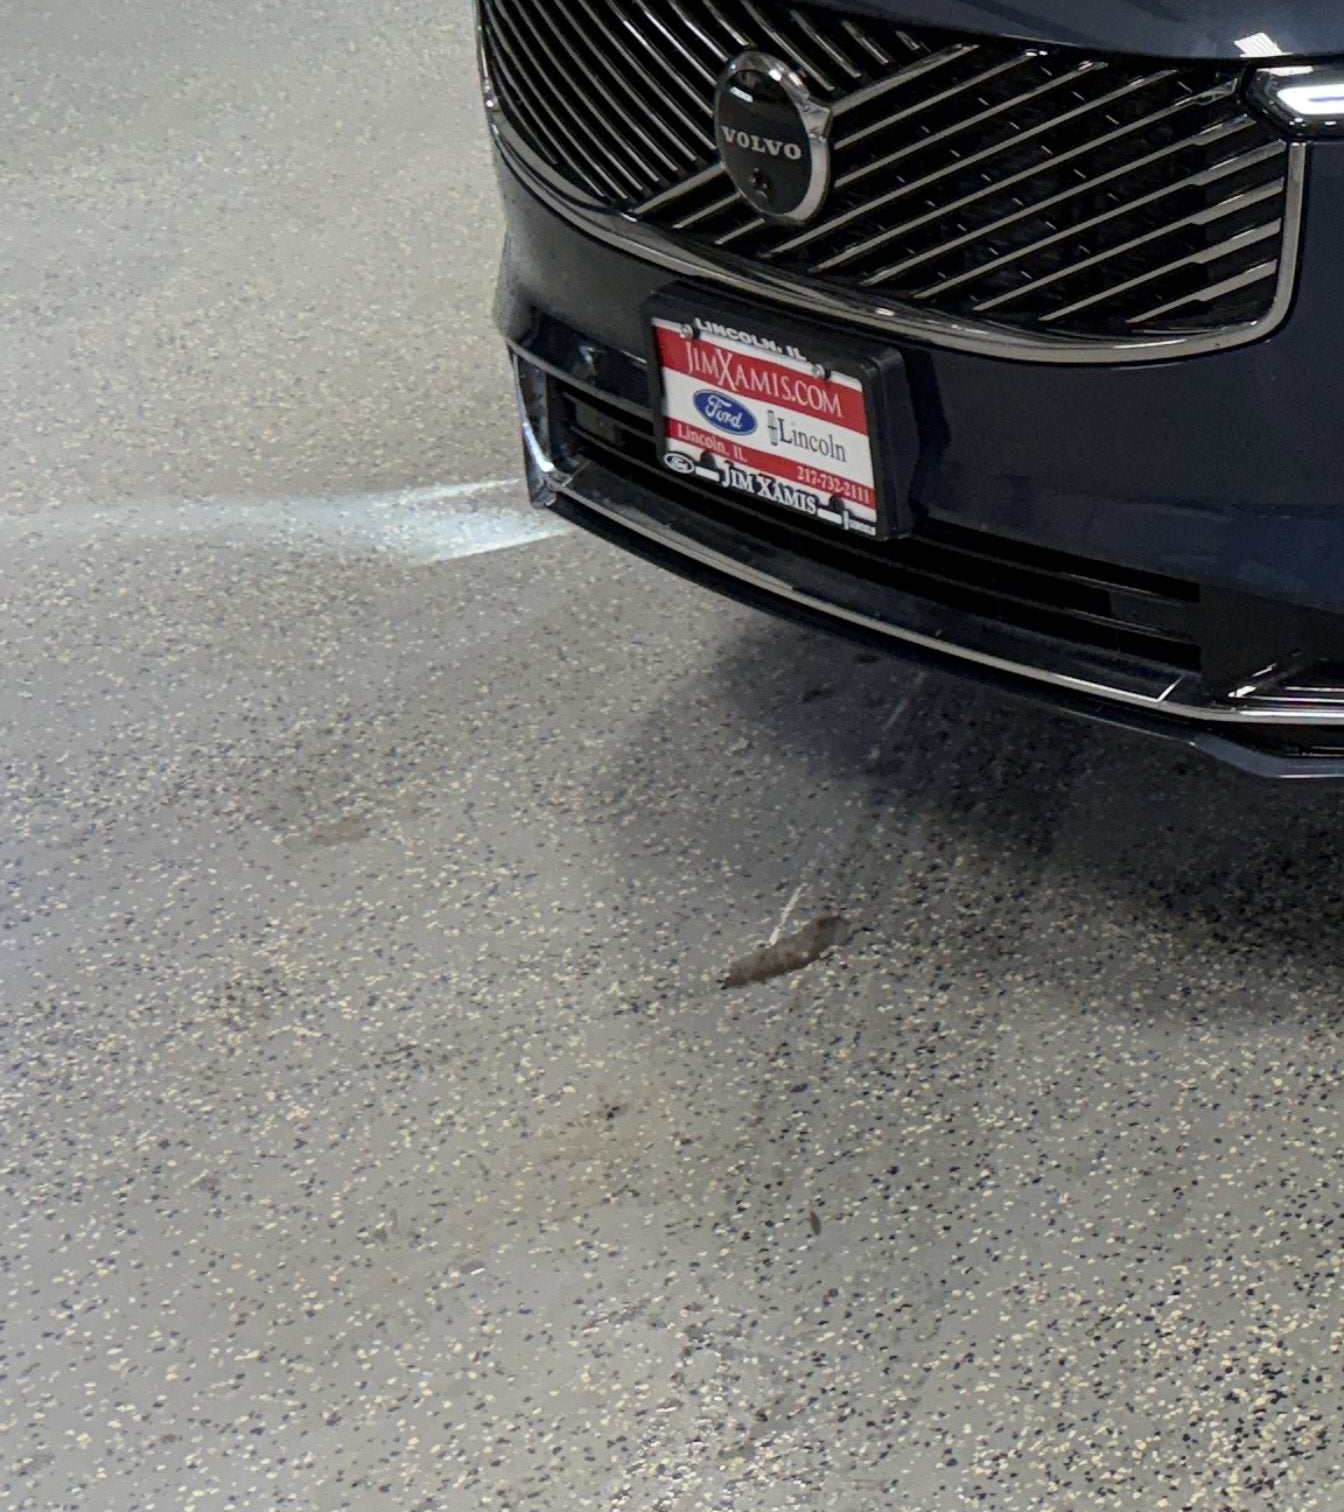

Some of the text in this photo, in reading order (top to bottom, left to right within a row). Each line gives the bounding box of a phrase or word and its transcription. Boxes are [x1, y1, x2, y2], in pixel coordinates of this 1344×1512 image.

[720, 125, 802, 160] VOLVO
[785, 345, 807, 362] IL
[685, 341, 844, 418] JIMXAMIS.COM
[704, 394, 743, 430] Ford
[733, 447, 749, 463] IL
[778, 418, 848, 463] Lincoln
[721, 463, 756, 495] JIM
[757, 475, 818, 515] XAMIS
